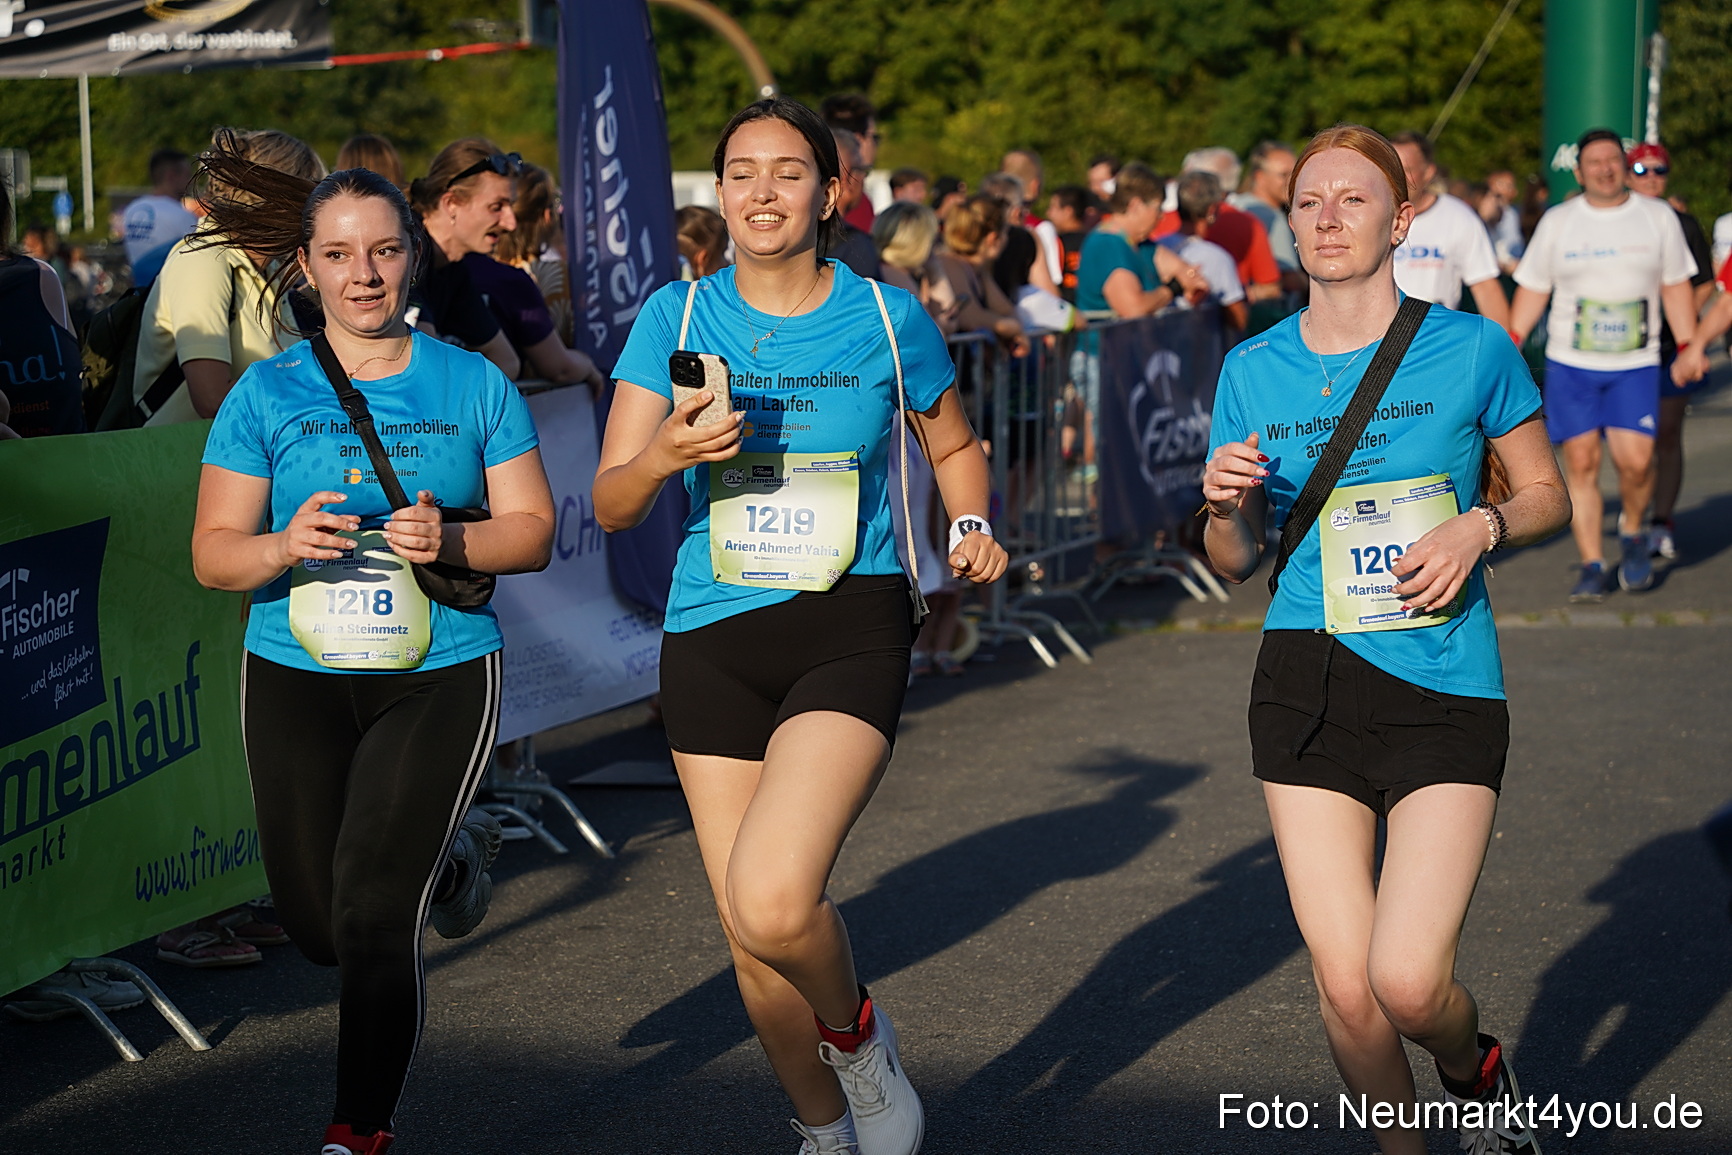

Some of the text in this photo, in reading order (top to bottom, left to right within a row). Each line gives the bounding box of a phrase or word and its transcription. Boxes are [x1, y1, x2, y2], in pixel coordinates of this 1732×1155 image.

[108, 33, 137, 51] Ein
[1248, 341, 1269, 351] JAKO
[777, 371, 860, 389] Immobilien
[734, 394, 818, 412] am Laufen.
[301, 421, 326, 436] Wir
[381, 419, 460, 436] Immobilien
[757, 422, 811, 431] immobilien
[757, 430, 792, 439] dienste
[1266, 423, 1291, 441] Wir
[1295, 414, 1342, 437] halten
[340, 441, 424, 458] am ufen.
[1356, 431, 1391, 451] ufen.
[1342, 456, 1386, 471] mmobilien
[746, 476, 790, 484] Firmenlauf
[746, 505, 815, 536] 1219
[1352, 510, 1391, 524] Firmenlauf
[725, 540, 839, 557] Arien Ahmed Yahia
[326, 558, 369, 567] Firmenlauf
[1350, 542, 1416, 576] 120
[1346, 583, 1394, 597] Marissa
[325, 588, 393, 616] 1218
[1, 588, 80, 642] Fischer
[347, 623, 409, 635] Steinmetz
[12, 620, 74, 660] AUTOMOBILE
[31, 669, 48, 696] und
[76, 662, 94, 686] mit!
